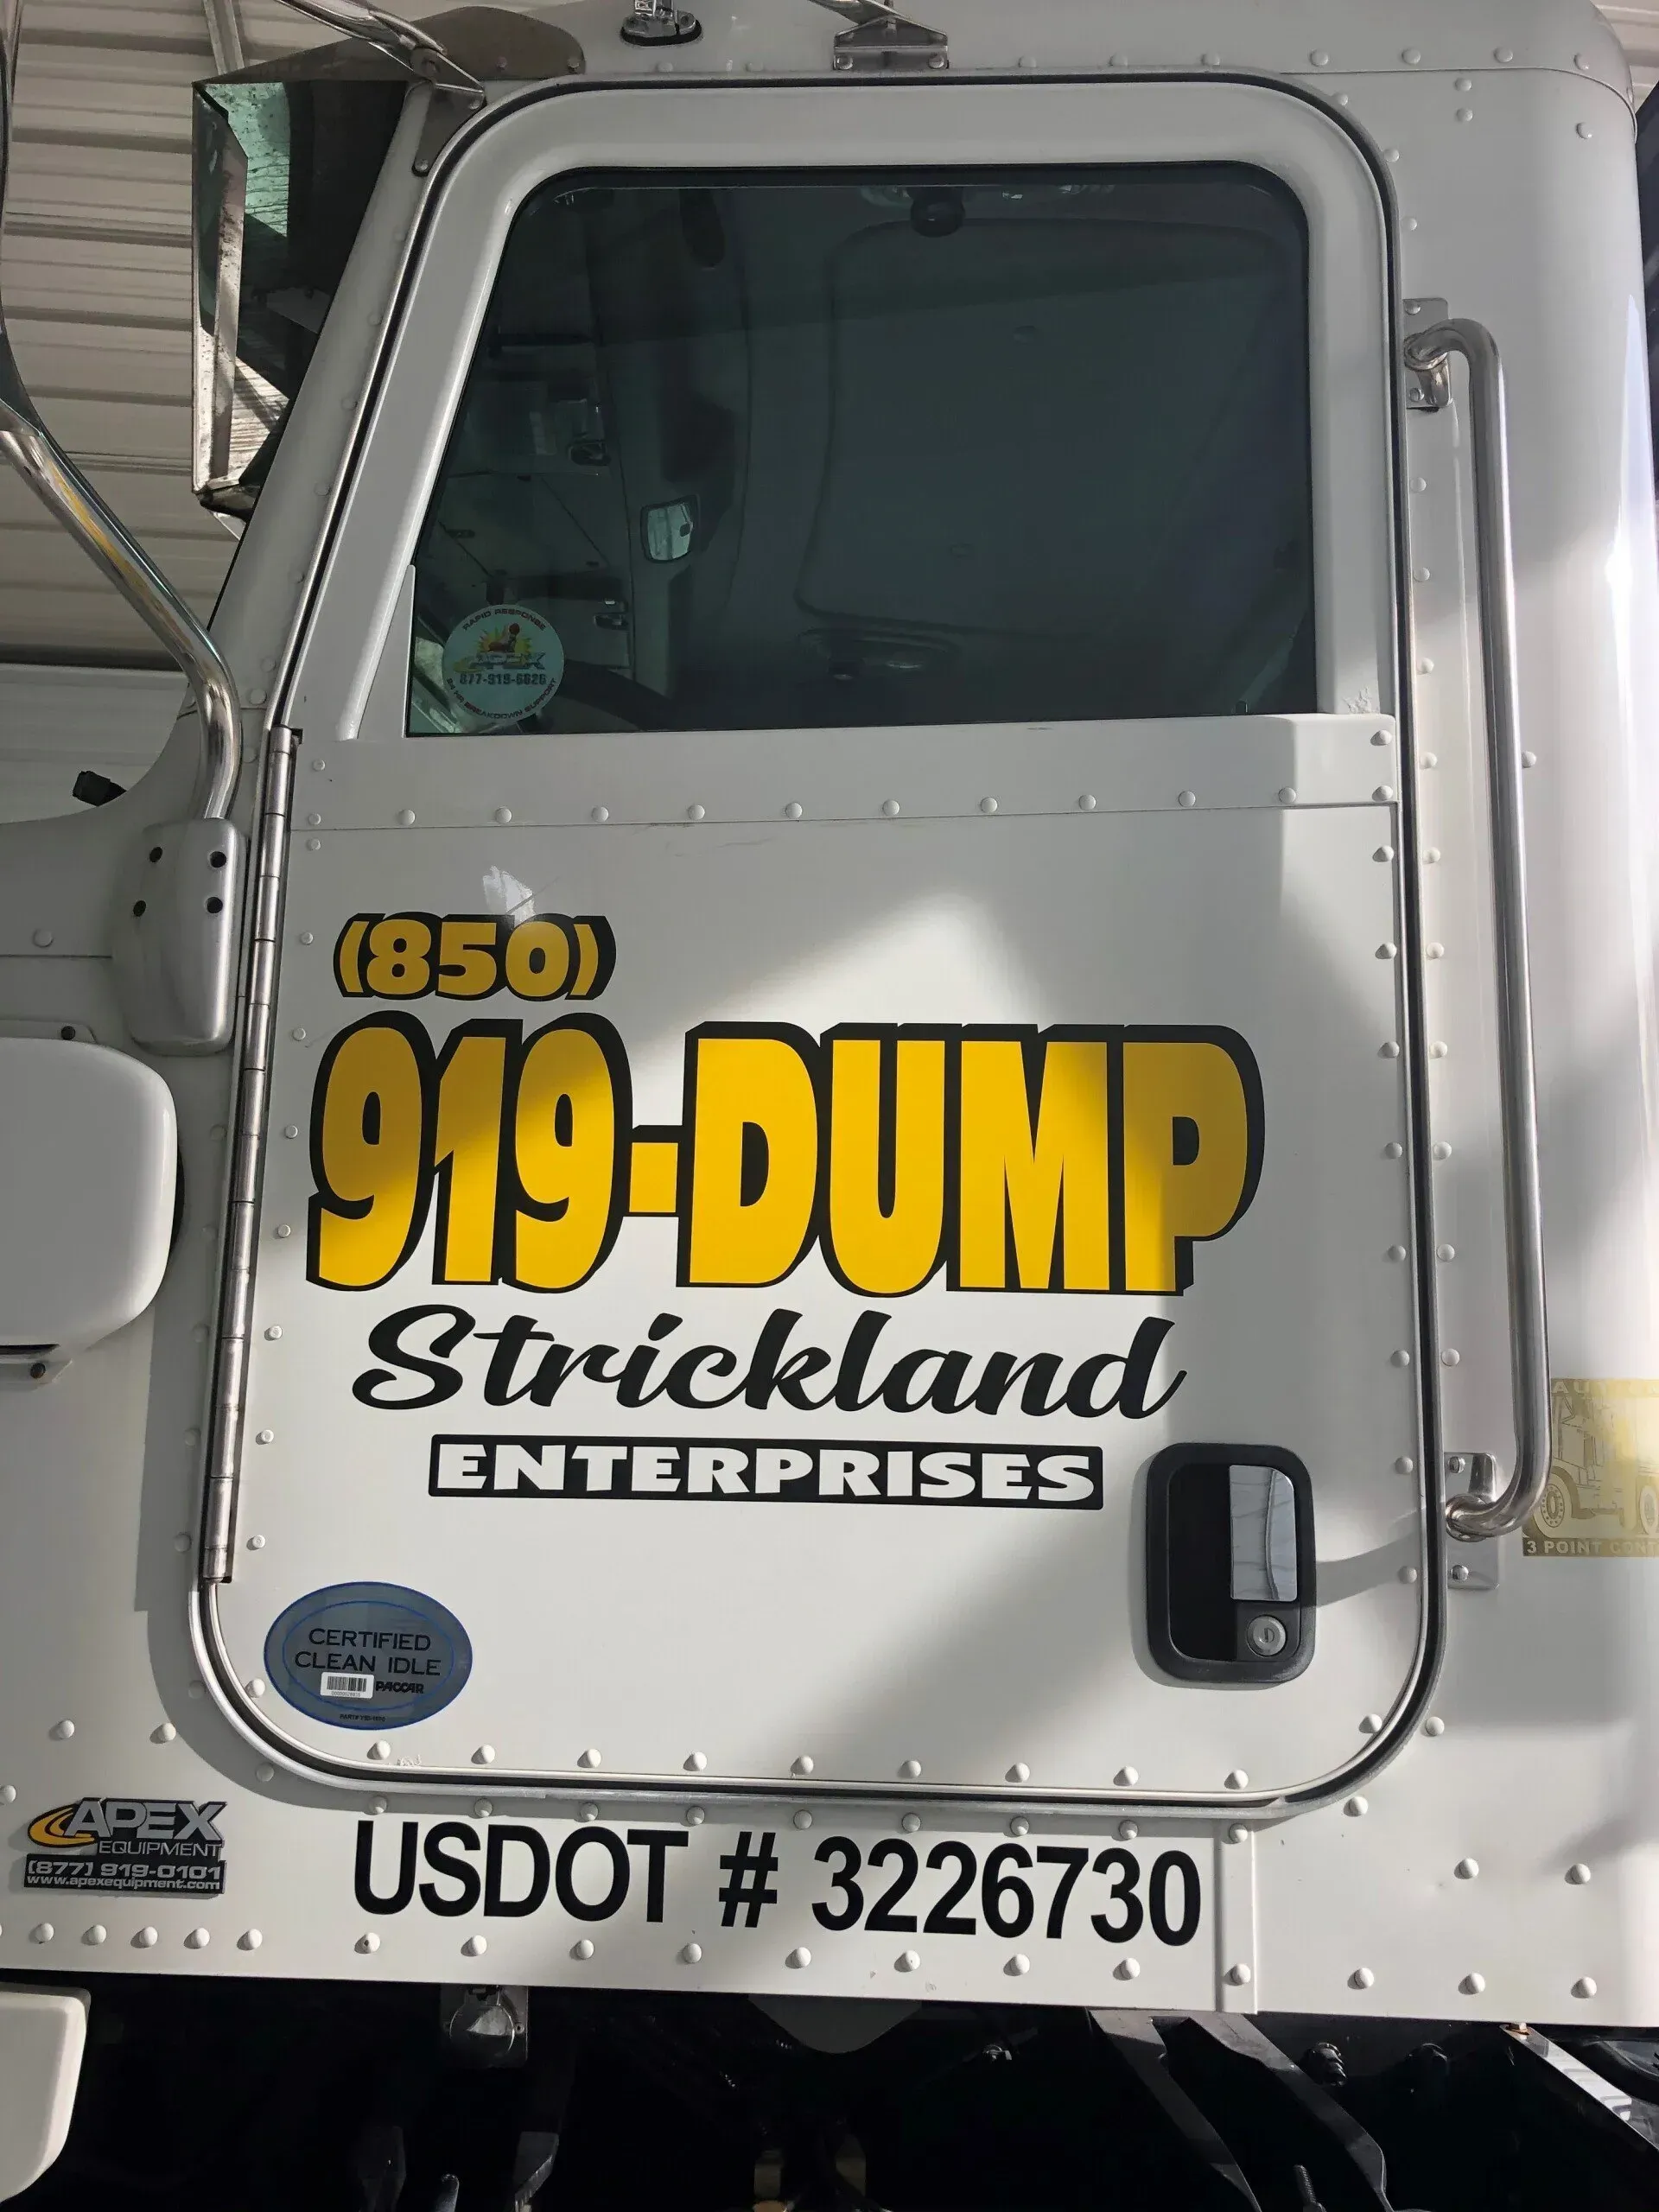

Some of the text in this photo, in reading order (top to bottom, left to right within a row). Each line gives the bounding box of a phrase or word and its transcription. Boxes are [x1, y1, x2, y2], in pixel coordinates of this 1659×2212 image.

[462, 608, 546, 631] RAPID RESPONSE
[463, 702, 523, 719] BREAKDOWN
[524, 677, 557, 712] SUPPORT
[334, 912, 615, 1001] (850)
[307, 1010, 1265, 1297] 919-DUMP
[353, 1304, 1187, 1419] Strickland
[436, 1443, 1095, 1503] ENTERPRISES
[1527, 1541, 1537, 1554] 3
[1544, 1541, 1602, 1555] POINT
[308, 1628, 431, 1651] CERTIFIED
[295, 1651, 441, 1675] CLEAN IDLE
[375, 1681, 424, 1694] PACCAR
[64, 1798, 226, 1841] APEX
[99, 1840, 221, 1857] EQUIPMENT
[28, 1860, 220, 1879] (877) 919-0101
[27, 1875, 220, 1890] www.apexequipment.com
[354, 1820, 1203, 1946] USDOT # 3226730
